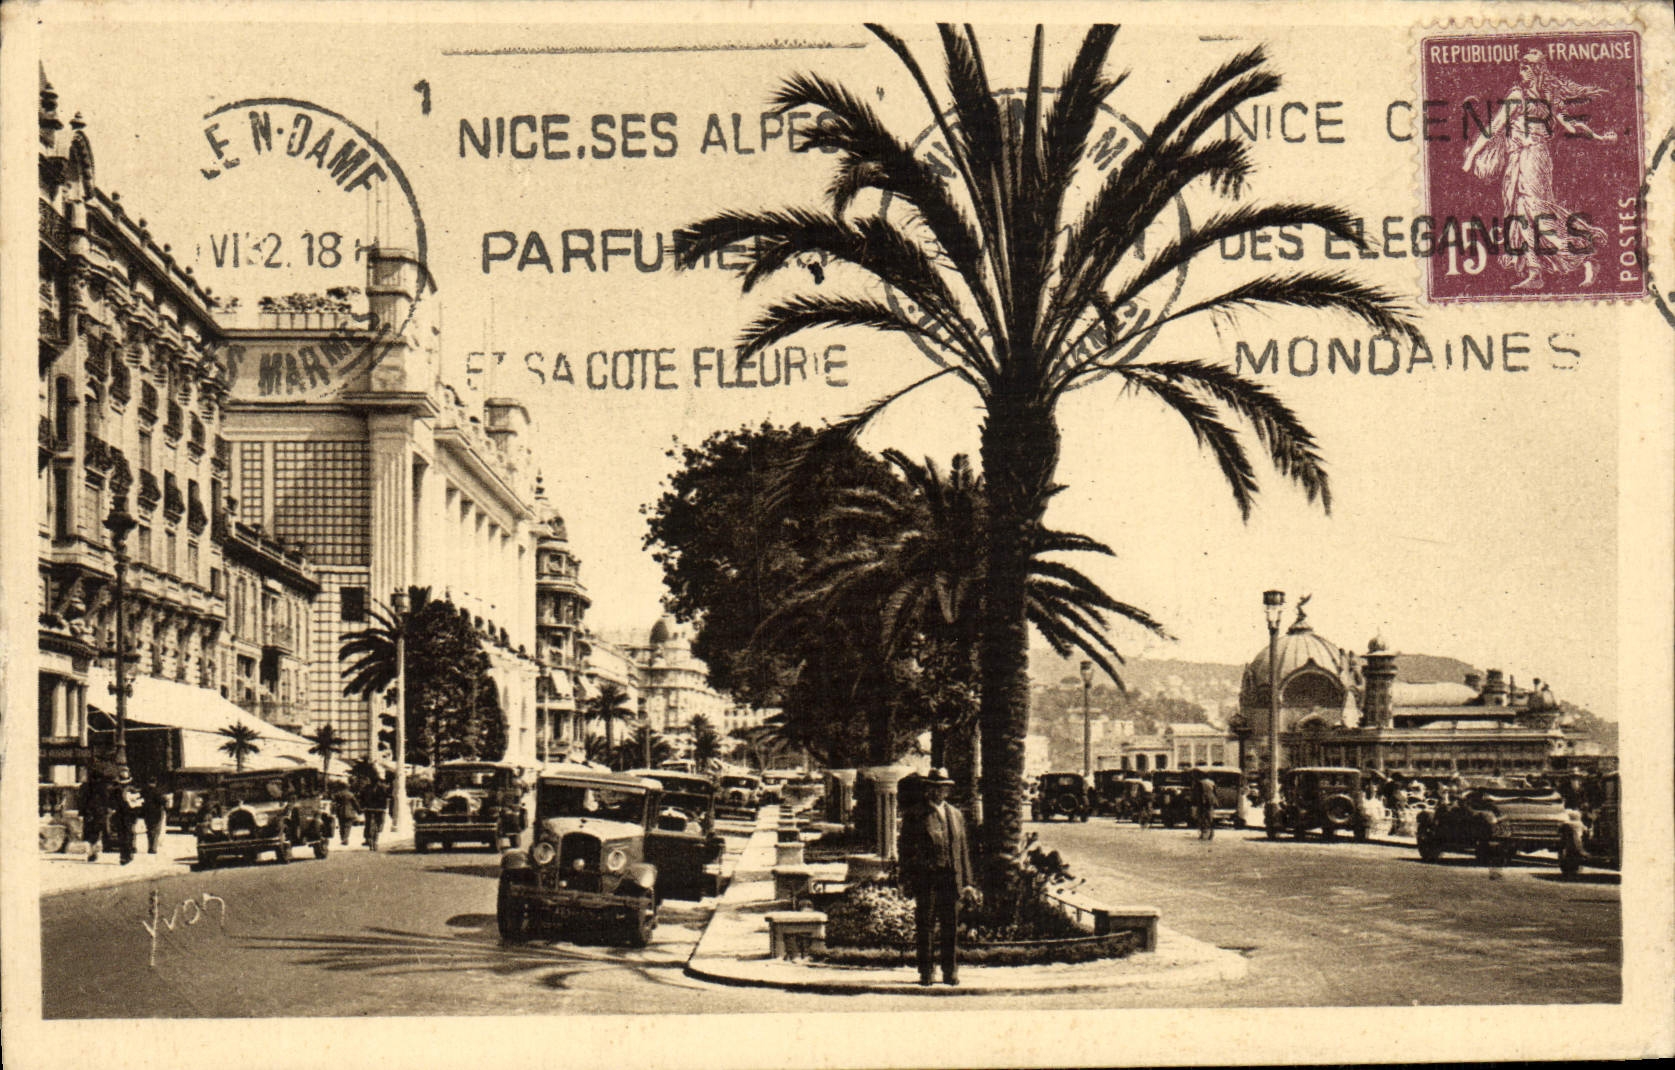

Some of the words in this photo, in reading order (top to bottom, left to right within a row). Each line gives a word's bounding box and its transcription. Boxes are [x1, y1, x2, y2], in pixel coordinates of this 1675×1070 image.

[1430, 43, 1520, 64] REPUBLIQUE
[700, 111, 841, 155] ALPES
[1225, 101, 1346, 144] NICE
[1386, 98, 1593, 143] CENTRE
[301, 231, 343, 268] 18
[1220, 222, 1305, 261] DES
[1618, 196, 1638, 282] POSTES
[524, 351, 575, 385] SA
[586, 348, 678, 390] COTE
[692, 344, 849, 389] FLEURIE
[1236, 332, 1581, 377] MONDAINES
